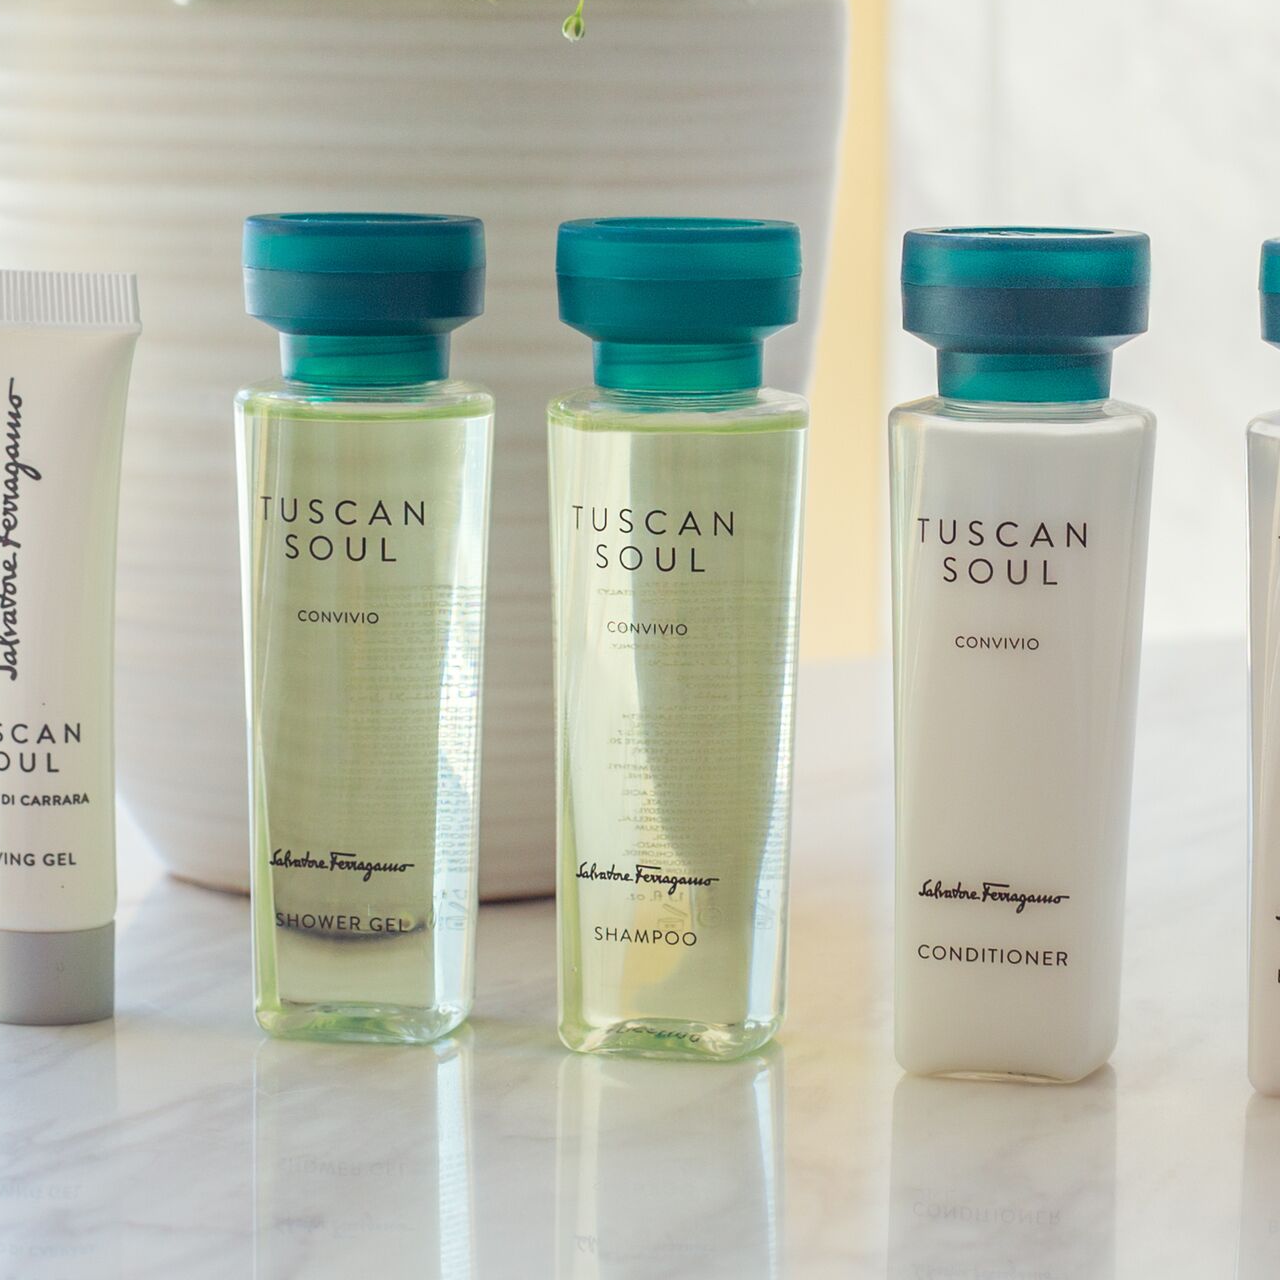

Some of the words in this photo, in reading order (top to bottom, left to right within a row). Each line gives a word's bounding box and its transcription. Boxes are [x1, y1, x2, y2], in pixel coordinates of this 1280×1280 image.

[261, 496, 425, 527] TUSCAN
[572, 505, 733, 536] TUSCAN
[918, 518, 1087, 548] TUSCAN
[285, 534, 397, 562] SOUL
[596, 544, 705, 572] SOUL
[943, 557, 1057, 585] SOUL
[298, 610, 379, 624] CONVIVIO
[607, 621, 687, 636] CONVIVIO
[955, 636, 1039, 650] CONVIVIO
[1, 793, 16, 806] DI
[20, 792, 90, 806] CARRARA
[43, 852, 77, 867] GEL
[269, 849, 329, 870] Salvatore
[331, 852, 415, 881] Ferragamo
[575, 861, 633, 882] Salvatore
[635, 863, 720, 896] Ferragamo
[918, 879, 979, 900] Salvatore
[982, 882, 1068, 912] Ferragamo
[275, 911, 361, 932] SHOWER
[368, 916, 410, 934] GEL
[595, 926, 697, 946] SHAMPOO
[918, 944, 1068, 966] CONDITIONER
